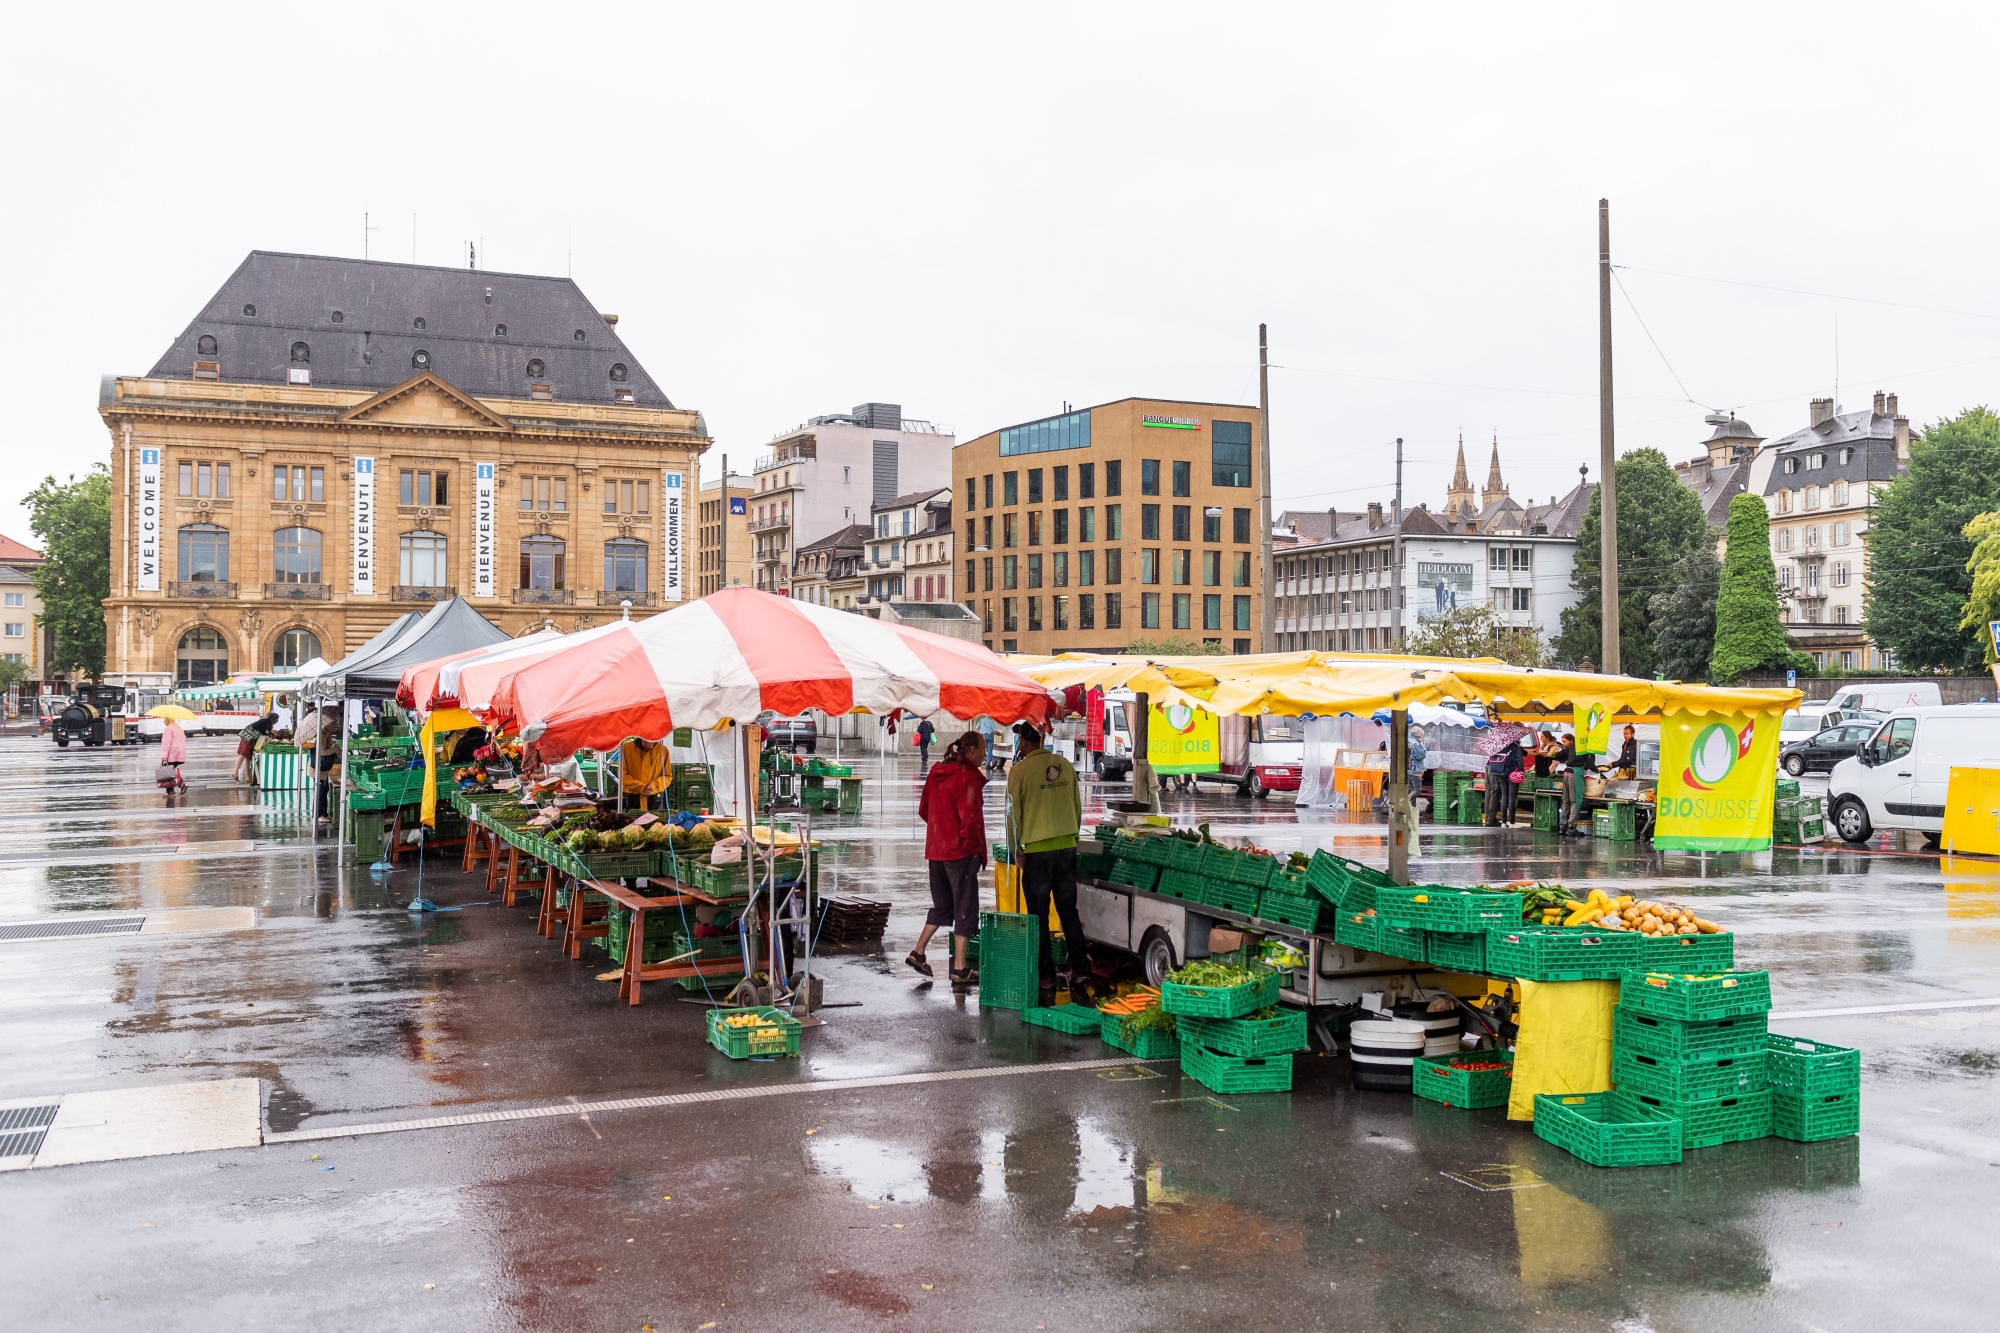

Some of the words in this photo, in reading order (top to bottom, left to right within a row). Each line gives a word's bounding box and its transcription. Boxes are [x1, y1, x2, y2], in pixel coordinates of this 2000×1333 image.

[277, 453, 322, 461] ARGENTINE
[143, 475, 156, 576] WELCOME
[358, 484, 369, 581] BENVENUTI
[480, 489, 490, 584] BIENVENUE
[730, 506, 744, 514] AXA
[668, 498, 679, 588] WILLKOMMEN
[1420, 564, 1472, 575] HEIDI.COM
[1660, 796, 1758, 820] BIOSUISSE
